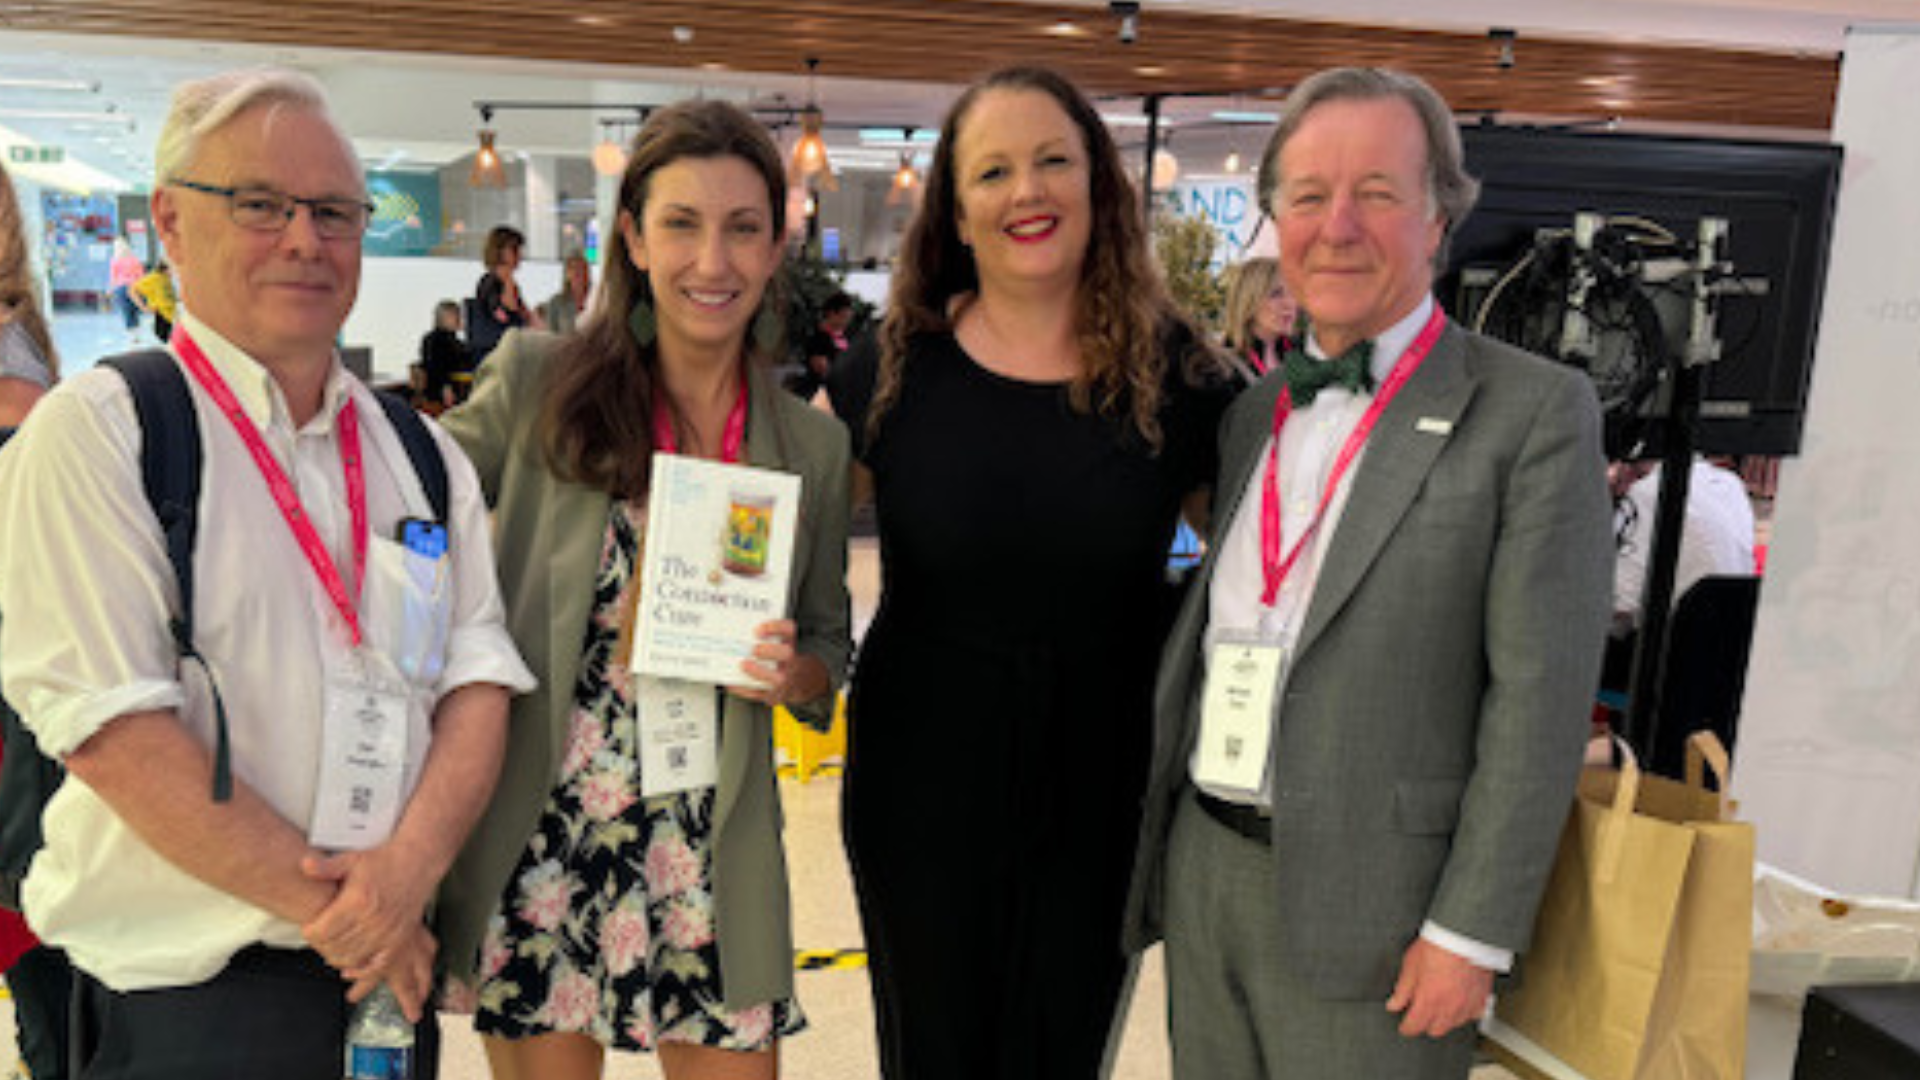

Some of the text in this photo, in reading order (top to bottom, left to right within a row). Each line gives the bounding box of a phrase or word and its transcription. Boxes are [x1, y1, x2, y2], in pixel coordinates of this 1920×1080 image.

[661, 556, 699, 578] The
[656, 579, 771, 612] Connection
[652, 602, 702, 626] Cure
